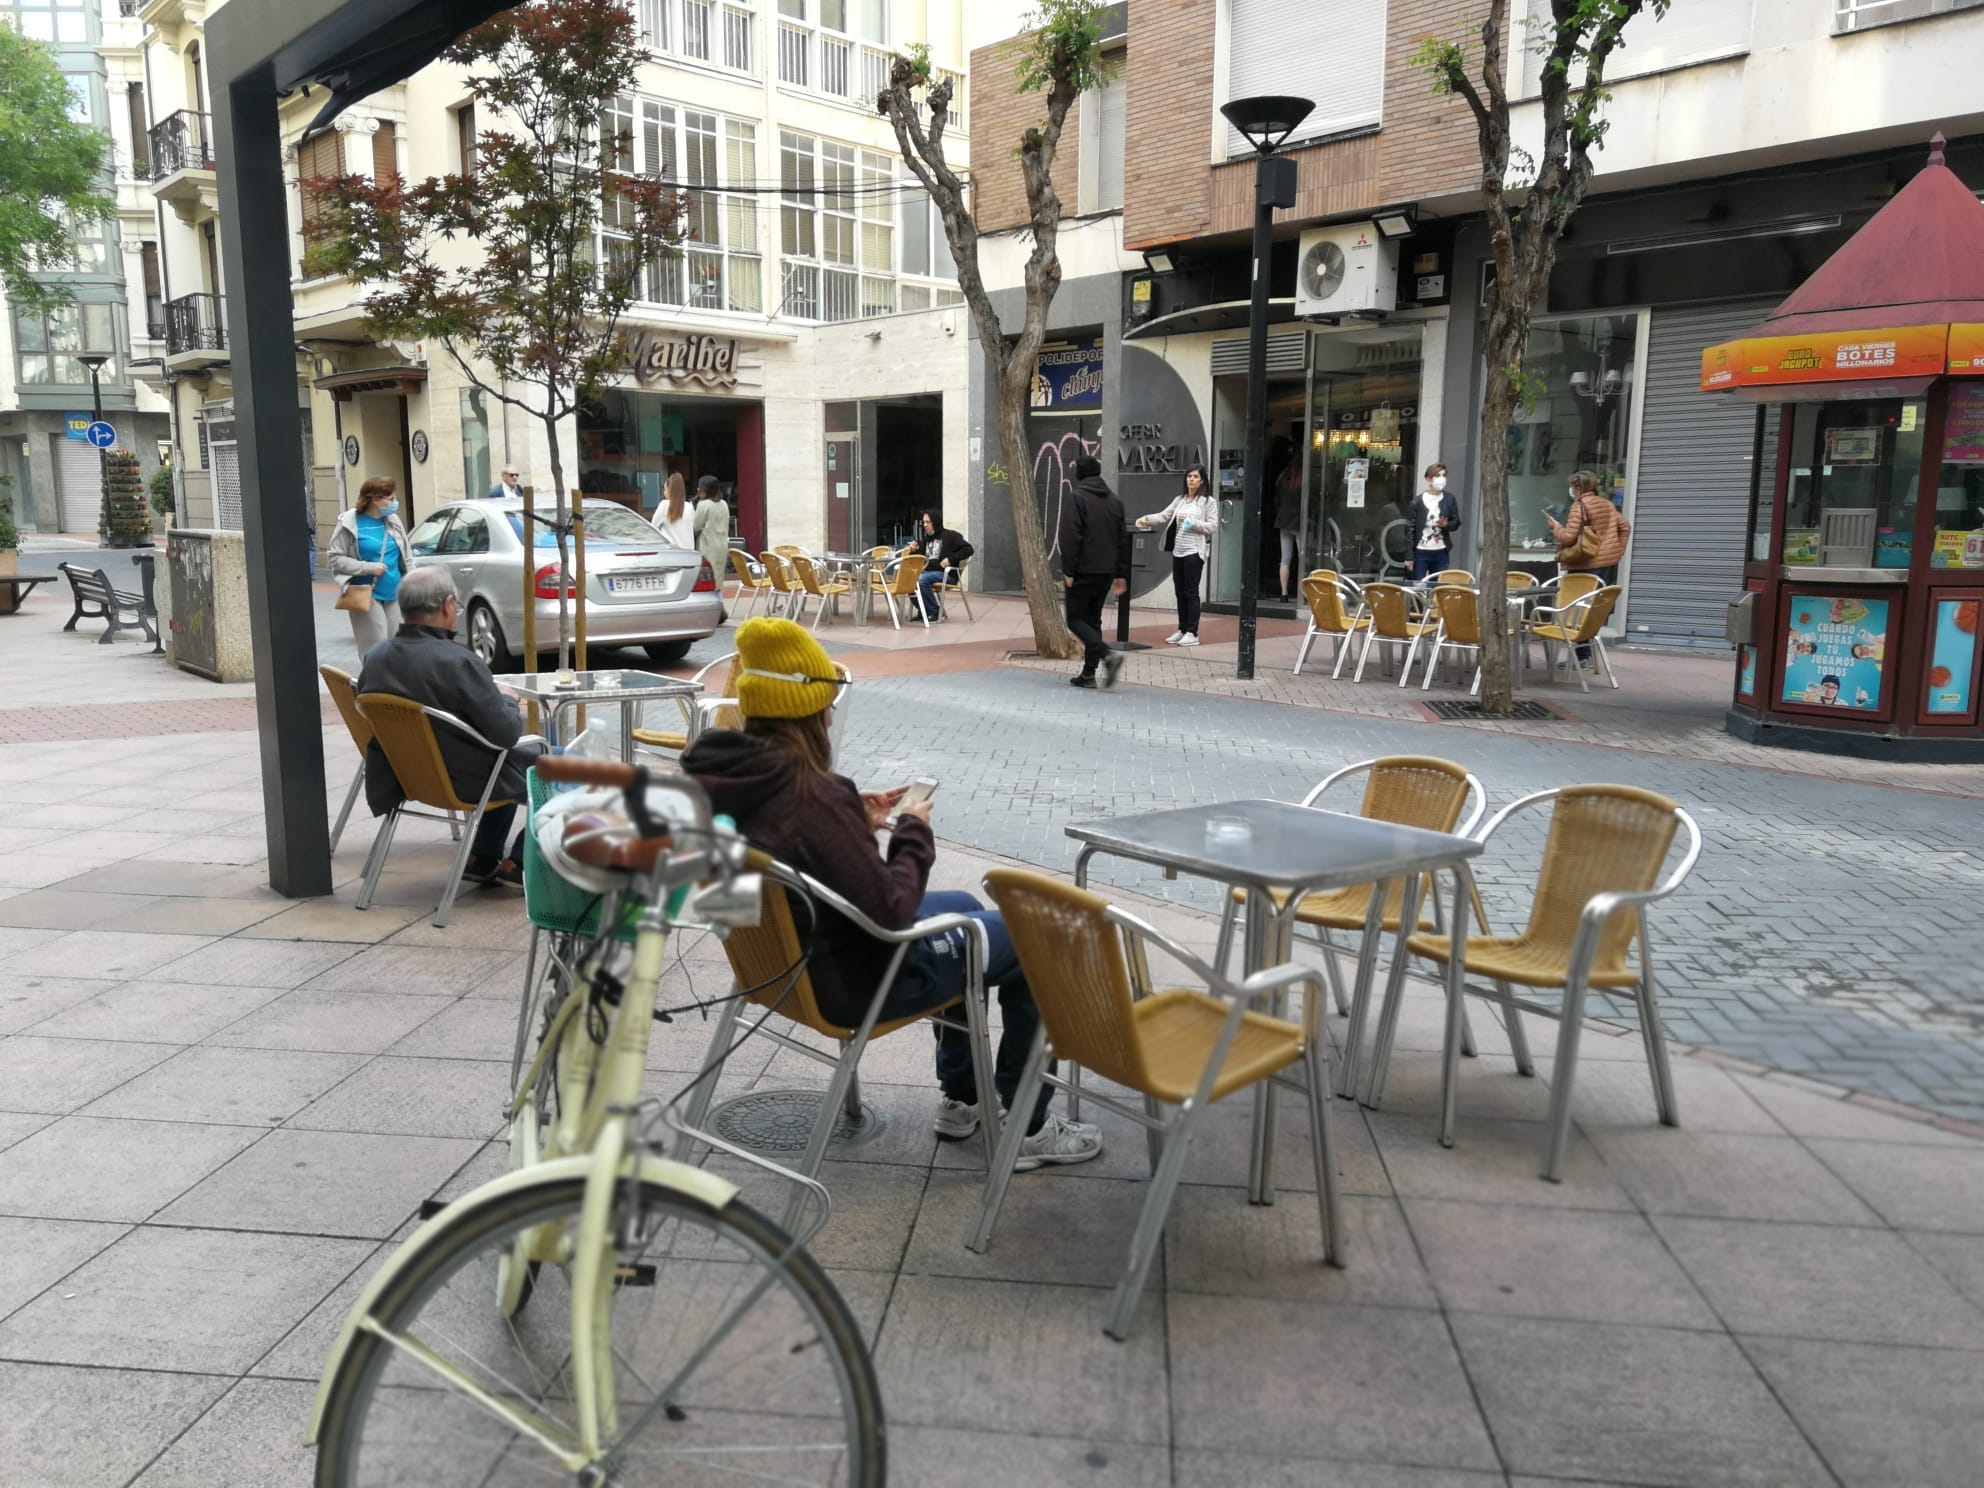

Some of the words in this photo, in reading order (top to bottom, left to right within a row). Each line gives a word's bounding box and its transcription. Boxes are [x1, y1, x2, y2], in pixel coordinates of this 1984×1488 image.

[622, 330, 739, 386] Maribel
[1836, 350, 1896, 361] BOTES
[1778, 358, 1824, 370] JACKPOT
[1836, 358, 1895, 368] MILLONARIOS
[645, 576, 664, 588] FFH
[1817, 623, 1856, 634] CUANDO
[1817, 634, 1852, 645] JUEGAS
[1811, 655, 1855, 667] JUGAMOS
[1817, 666, 1847, 677] TODOS
